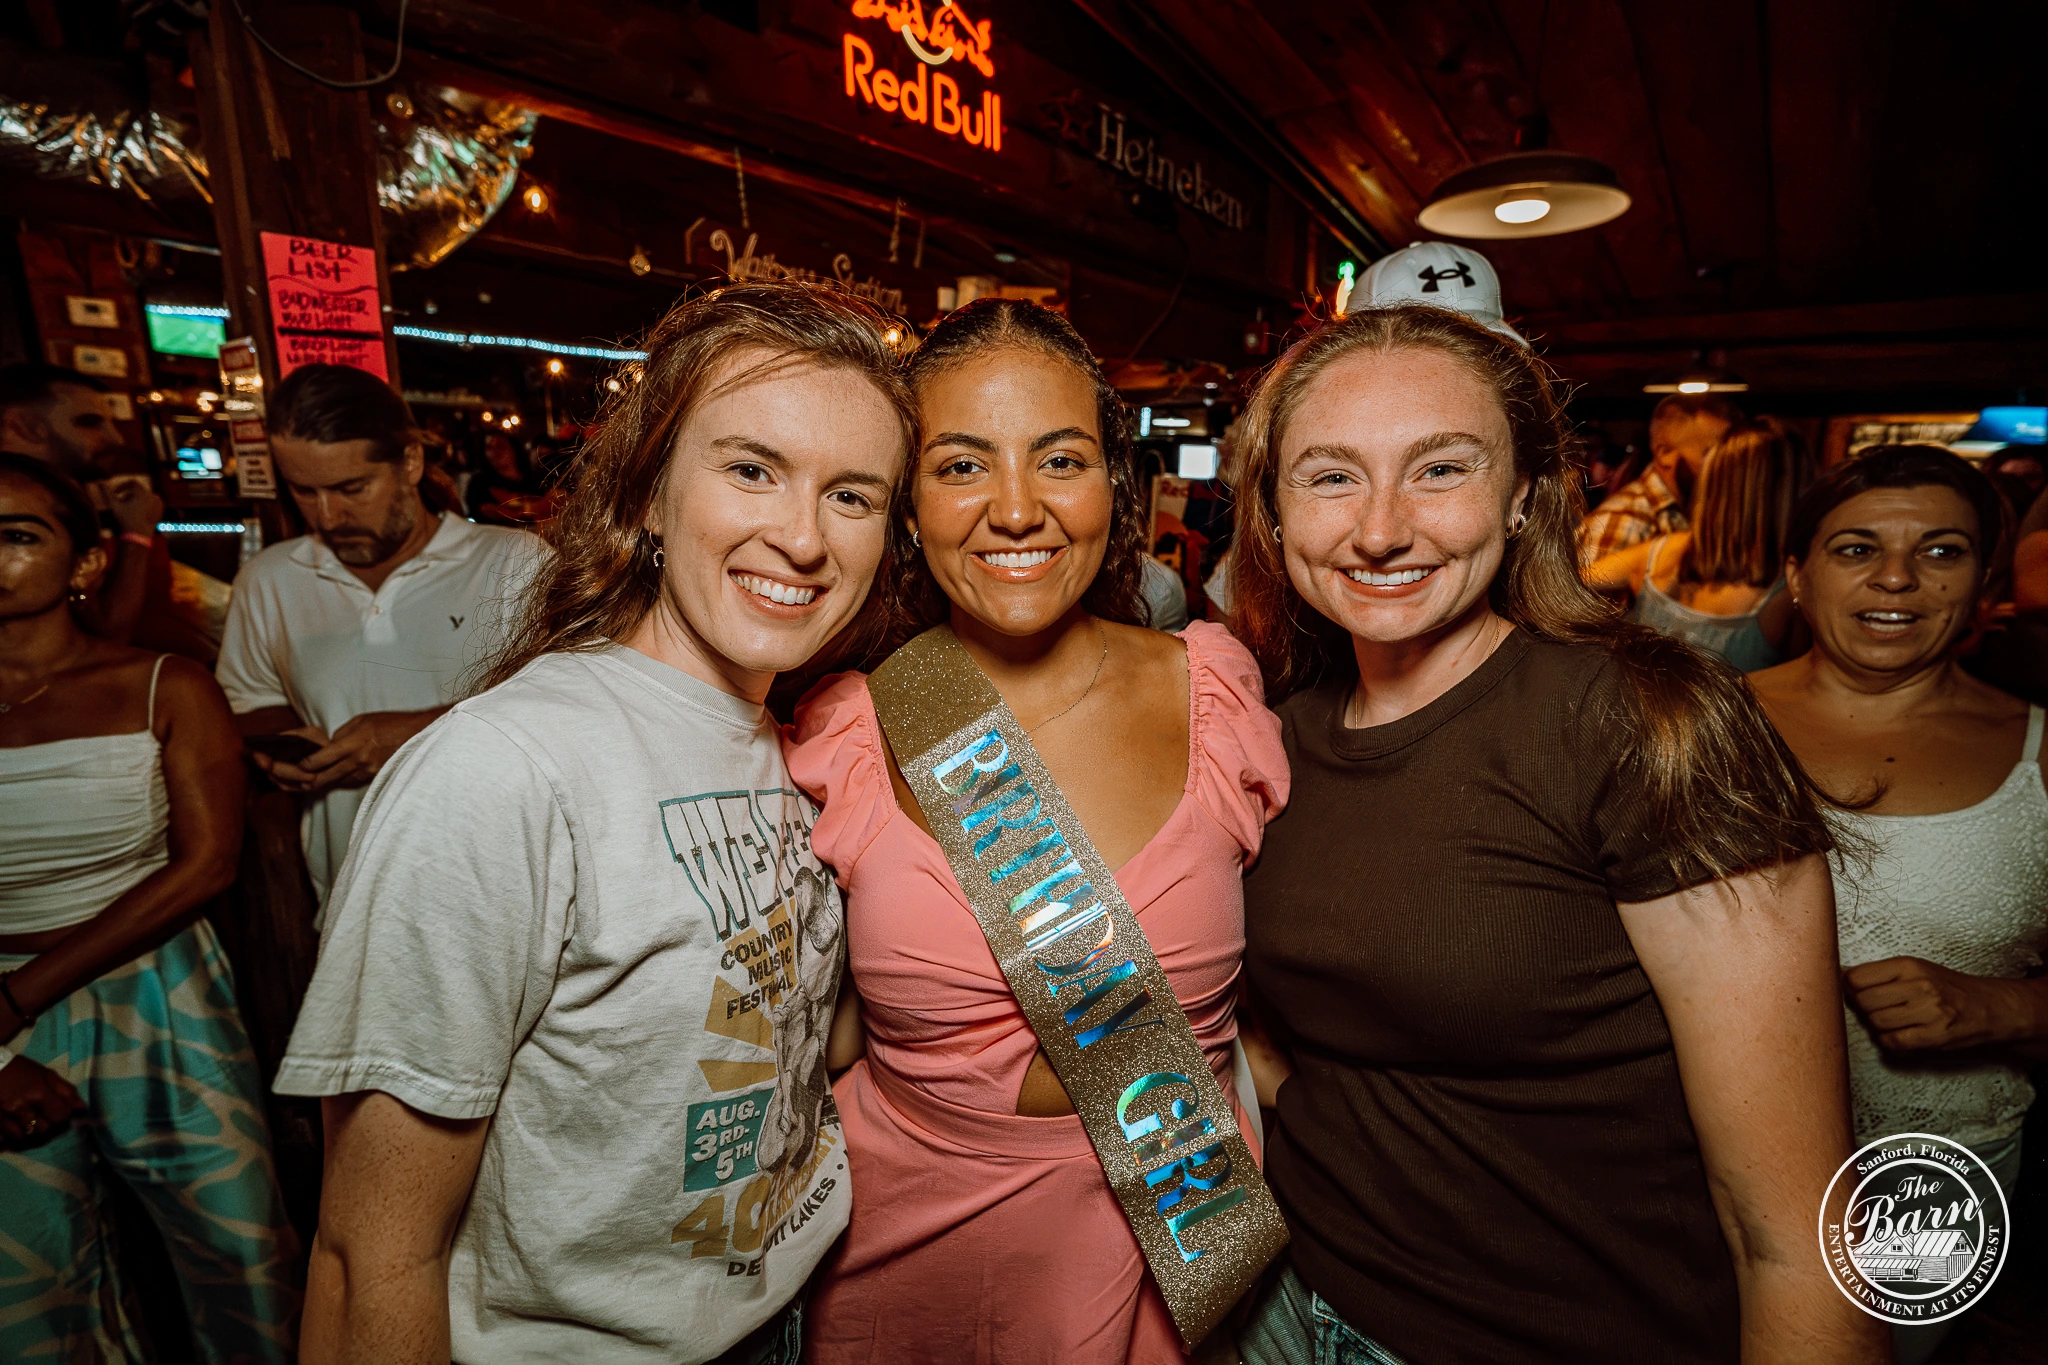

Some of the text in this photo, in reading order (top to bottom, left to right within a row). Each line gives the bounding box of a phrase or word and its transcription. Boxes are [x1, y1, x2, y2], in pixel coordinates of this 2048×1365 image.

[843, 32, 1001, 152] Red Bull
[1095, 101, 1243, 231] Heineken
[288, 256, 351, 282] LIST
[289, 238, 358, 264] BEER
[720, 918, 793, 971] COUNTRY
[747, 946, 793, 986] MUSIC
[726, 972, 794, 1020] FESTIVAL
[931, 727, 1249, 1264] BIRTHDAY GIRL
[695, 1099, 761, 1132] AUG.
[714, 1140, 753, 1181] 5TH
[790, 1177, 837, 1234] LAKES
